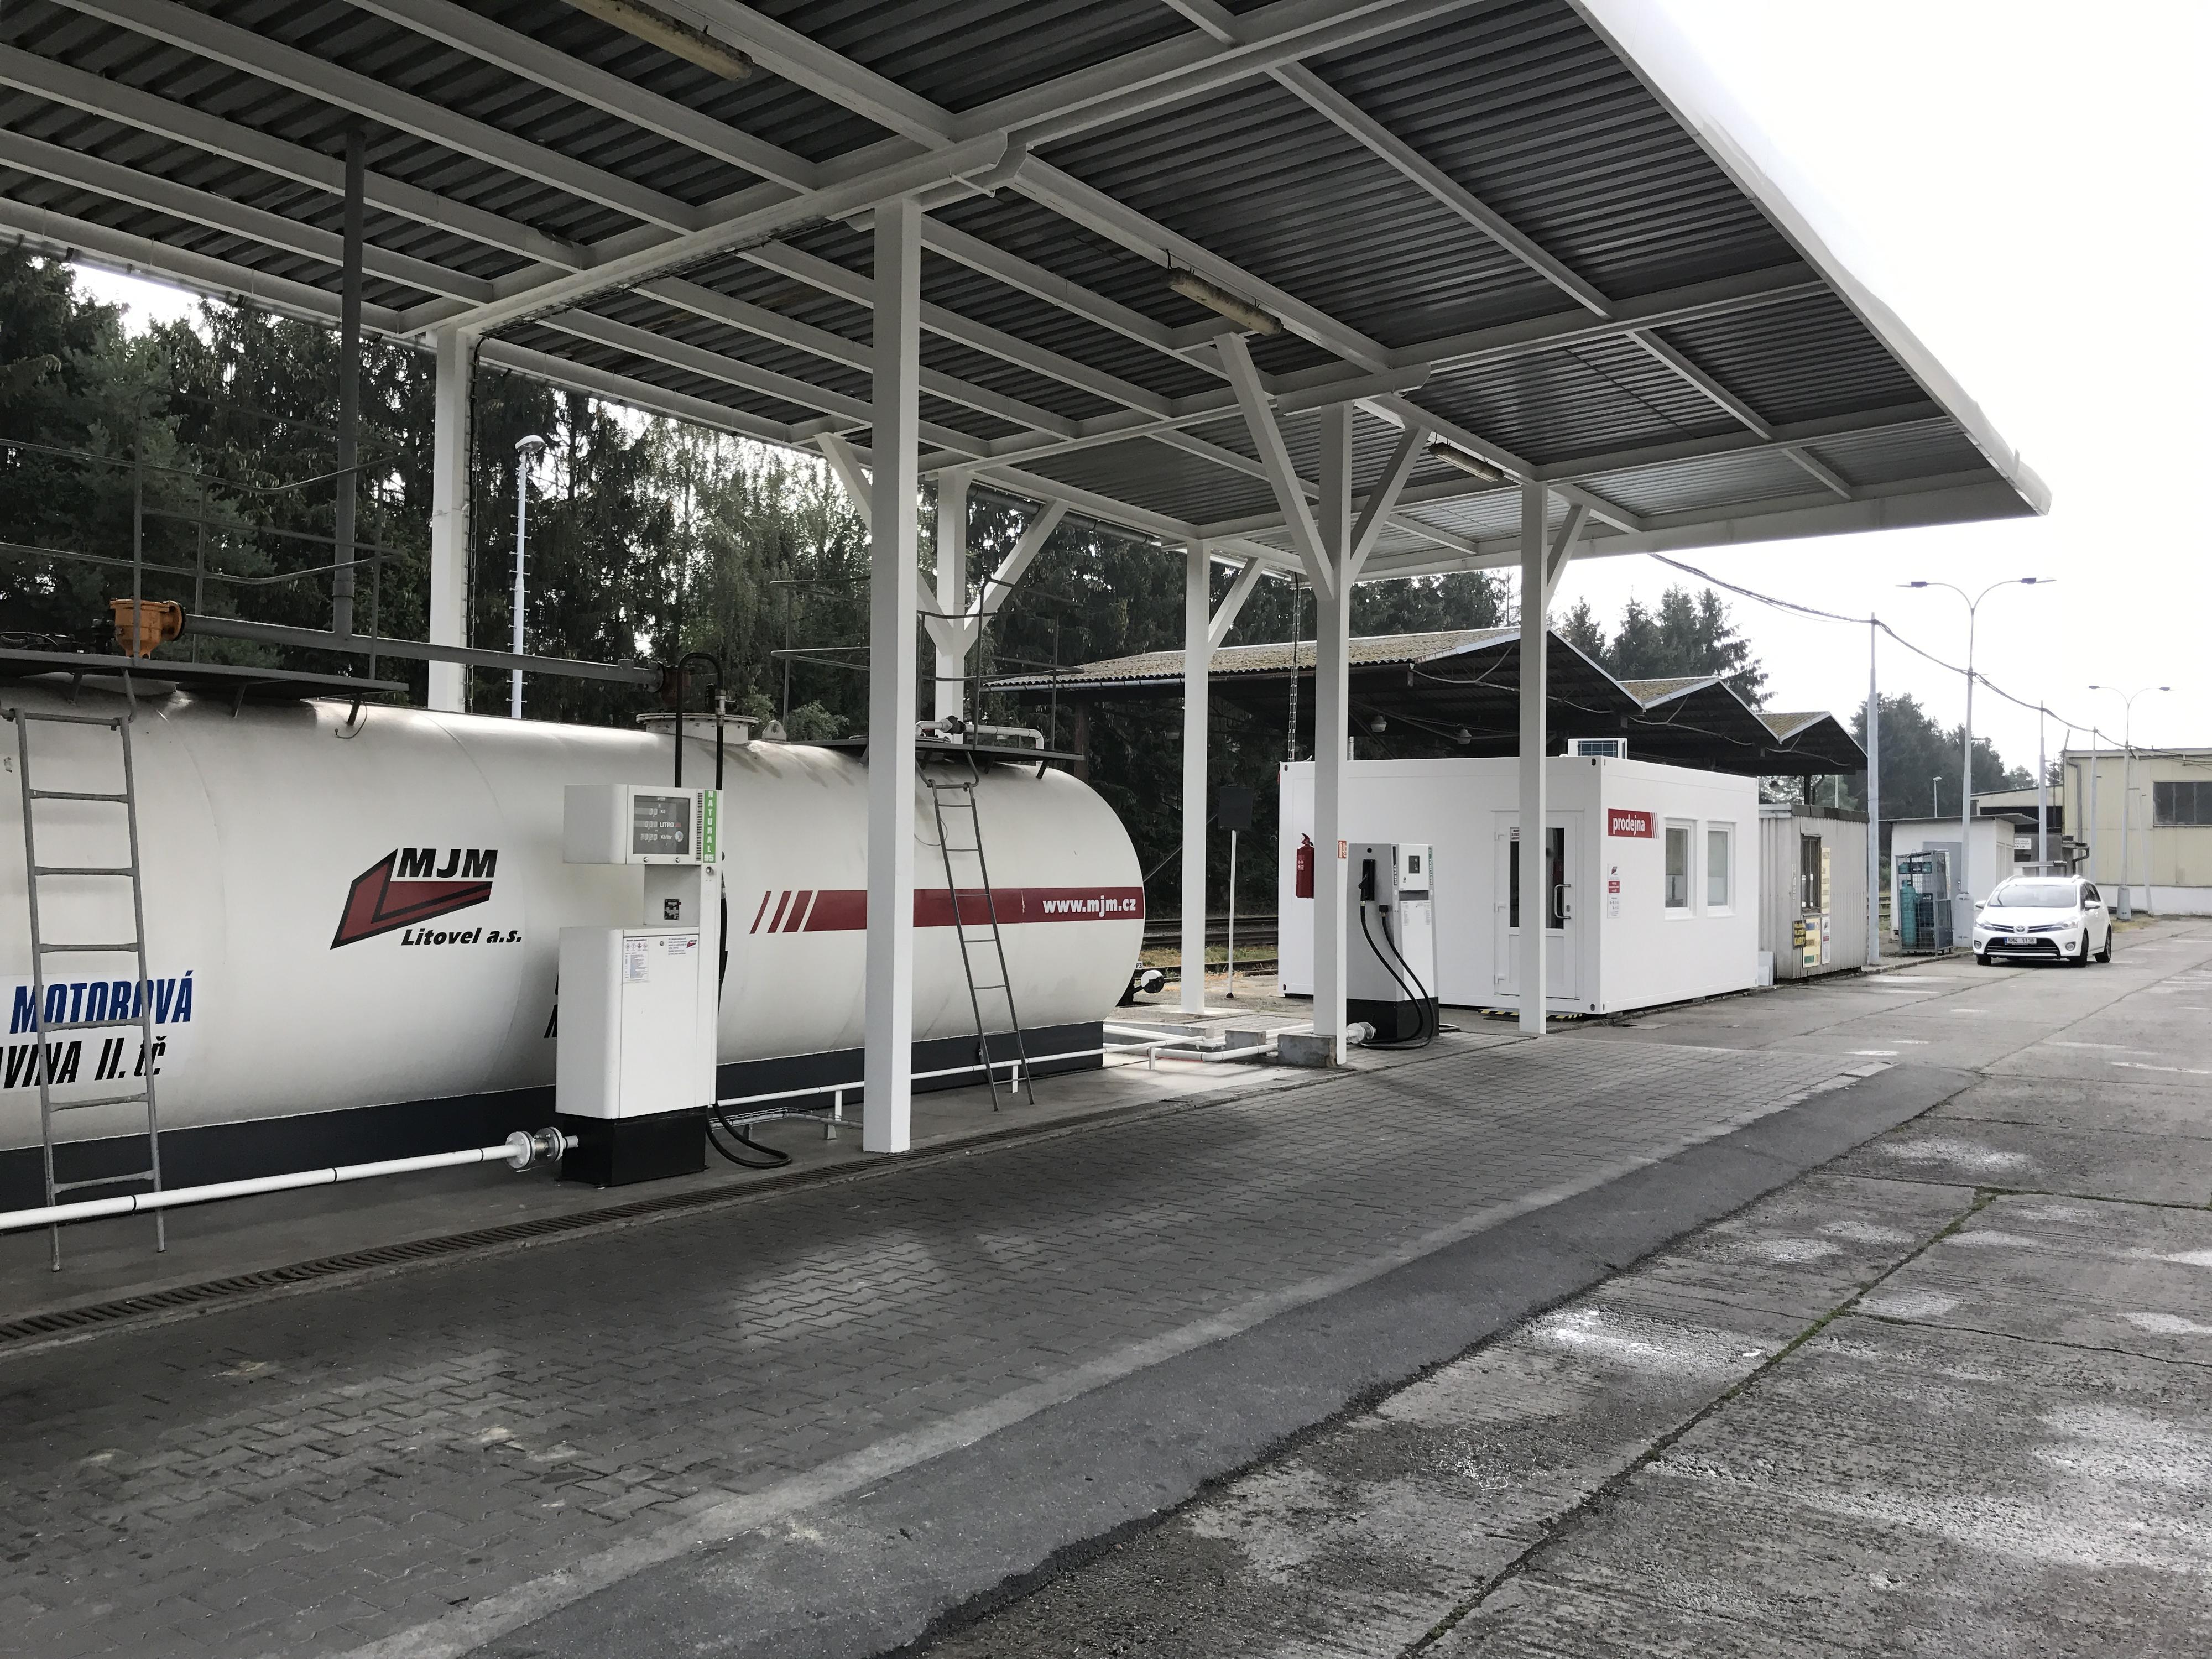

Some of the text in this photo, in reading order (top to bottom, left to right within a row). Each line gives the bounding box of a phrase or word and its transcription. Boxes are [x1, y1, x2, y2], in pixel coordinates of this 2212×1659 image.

[1613, 813, 1645, 836] prodejna
[397, 848, 498, 878] MJM
[1043, 895, 1136, 917] www.mjm.cz
[401, 927, 522, 946] Litovel a.s.
[9, 970, 194, 1034] MOTOROVÁ
[94, 1037, 127, 1081] II.
